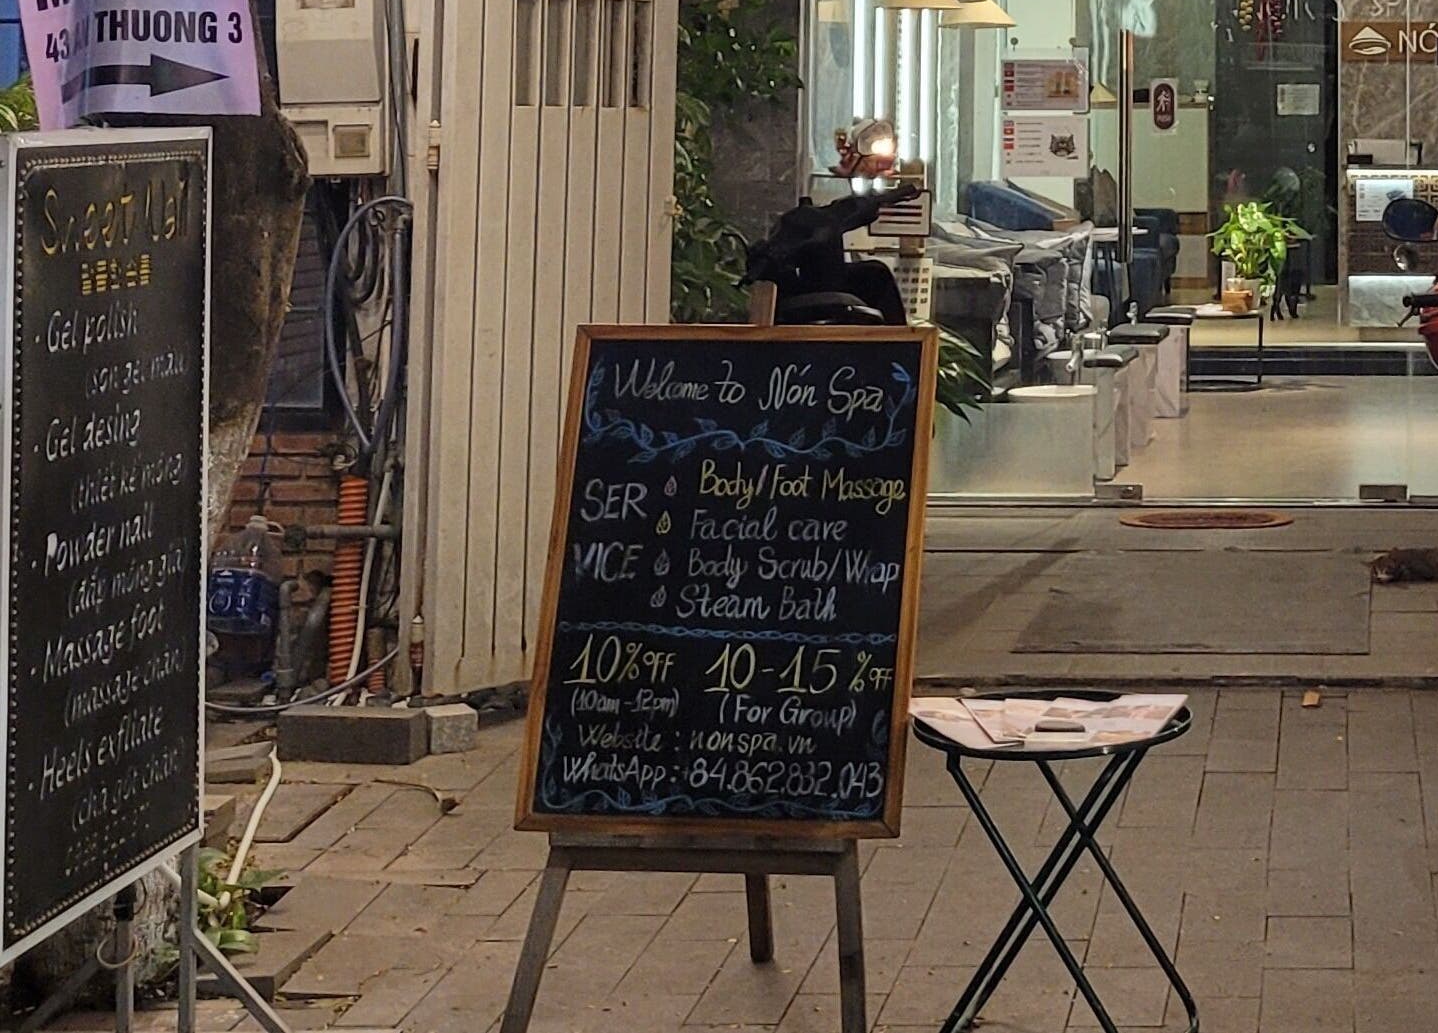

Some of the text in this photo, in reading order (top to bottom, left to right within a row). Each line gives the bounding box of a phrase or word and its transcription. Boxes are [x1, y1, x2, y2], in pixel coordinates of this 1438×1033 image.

[46, 28, 70, 63] 43
[94, 9, 218, 44] THUONG
[228, 11, 243, 44] 3
[47, 300, 139, 355] Gel polish
[614, 358, 886, 423] Welcome to Nón Spa
[45, 417, 76, 462] Gel
[580, 477, 649, 524] SER
[820, 468, 908, 516] Massage
[45, 501, 154, 577] Powder nail
[689, 501, 849, 542] Facial care
[572, 541, 644, 585] VICE
[687, 546, 749, 590] Body
[675, 583, 838, 623] Steam Bath
[43, 597, 166, 684] Massage foot
[778, 695, 858, 736] Group)
[689, 730, 816, 756] nonspa.vn
[39, 734, 92, 801] Heels
